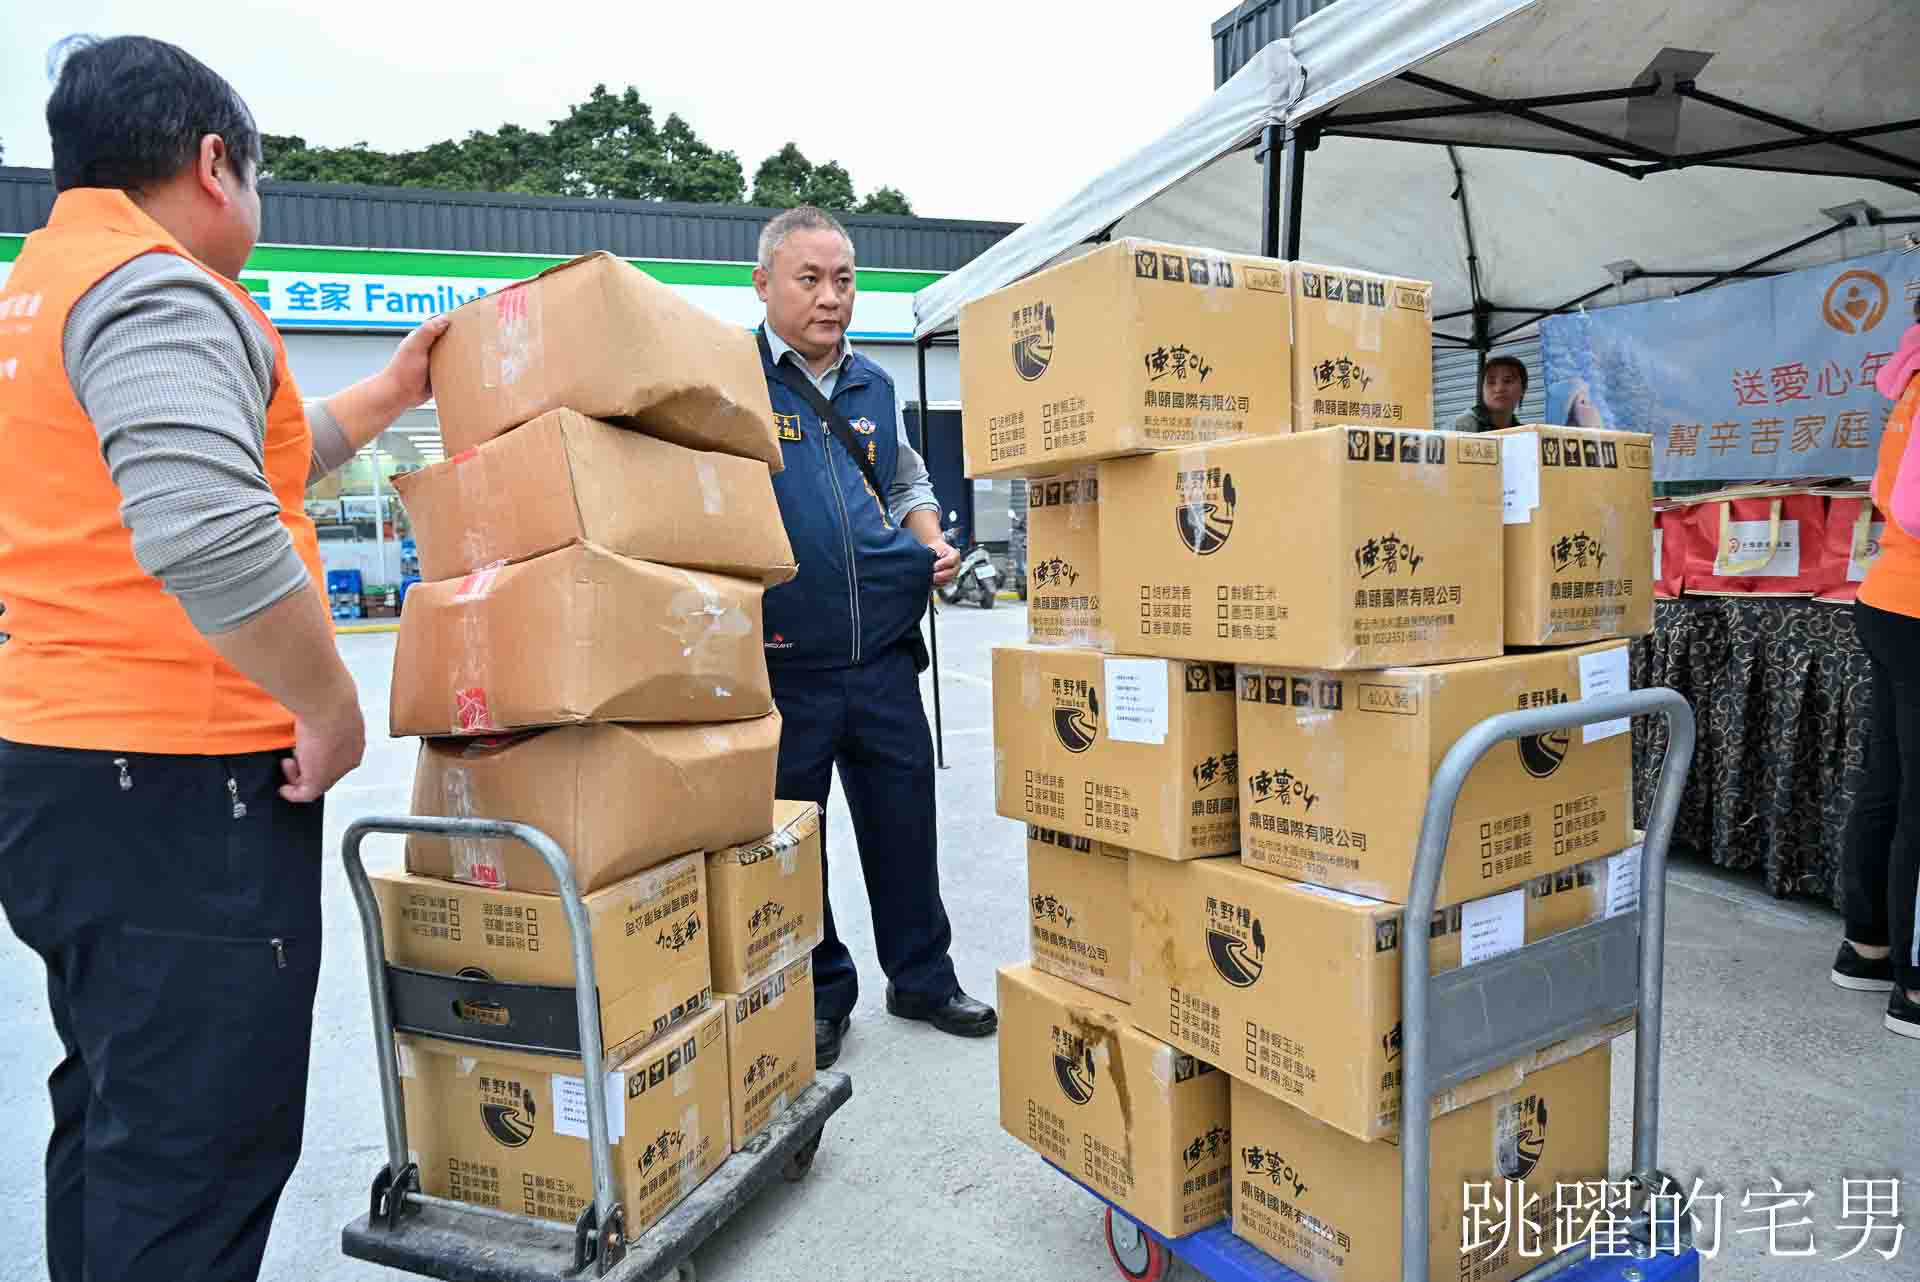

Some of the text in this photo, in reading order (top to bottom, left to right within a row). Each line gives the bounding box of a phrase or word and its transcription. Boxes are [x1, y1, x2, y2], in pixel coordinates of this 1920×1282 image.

[286, 281, 350, 312] 全家
[1144, 390, 1249, 414] 鼎頤國際有限公司
[1312, 399, 1403, 421] 鼎頤國際有限公司
[1354, 585, 1462, 609] 鼎頤國際有限公司
[1550, 579, 1633, 600] 鼎頤國際有限公司
[1248, 811, 1367, 852] 鼎頤國際有限公司
